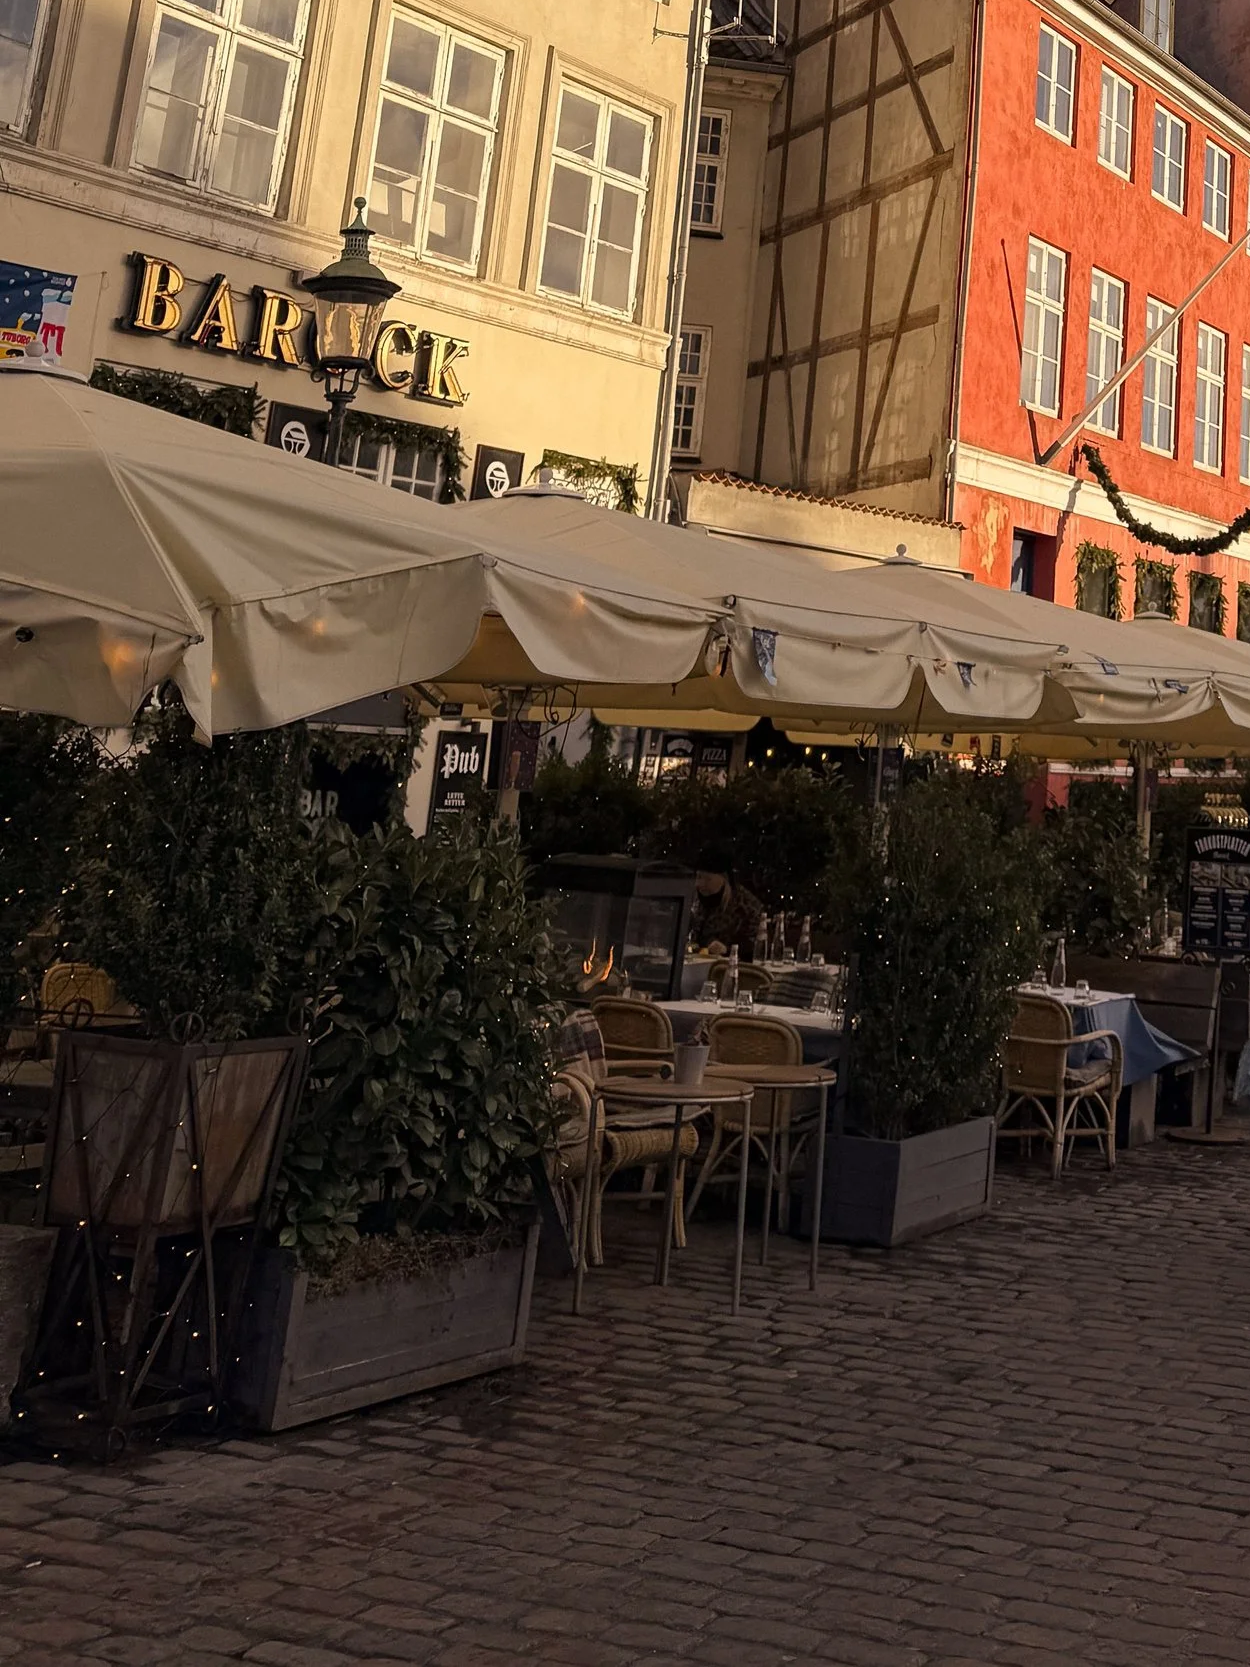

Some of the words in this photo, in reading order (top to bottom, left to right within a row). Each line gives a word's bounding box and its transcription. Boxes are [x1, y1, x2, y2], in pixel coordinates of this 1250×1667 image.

[118, 251, 472, 407] BARCK
[440, 743, 480, 779] Pub
[702, 748, 727, 761] PIZZA
